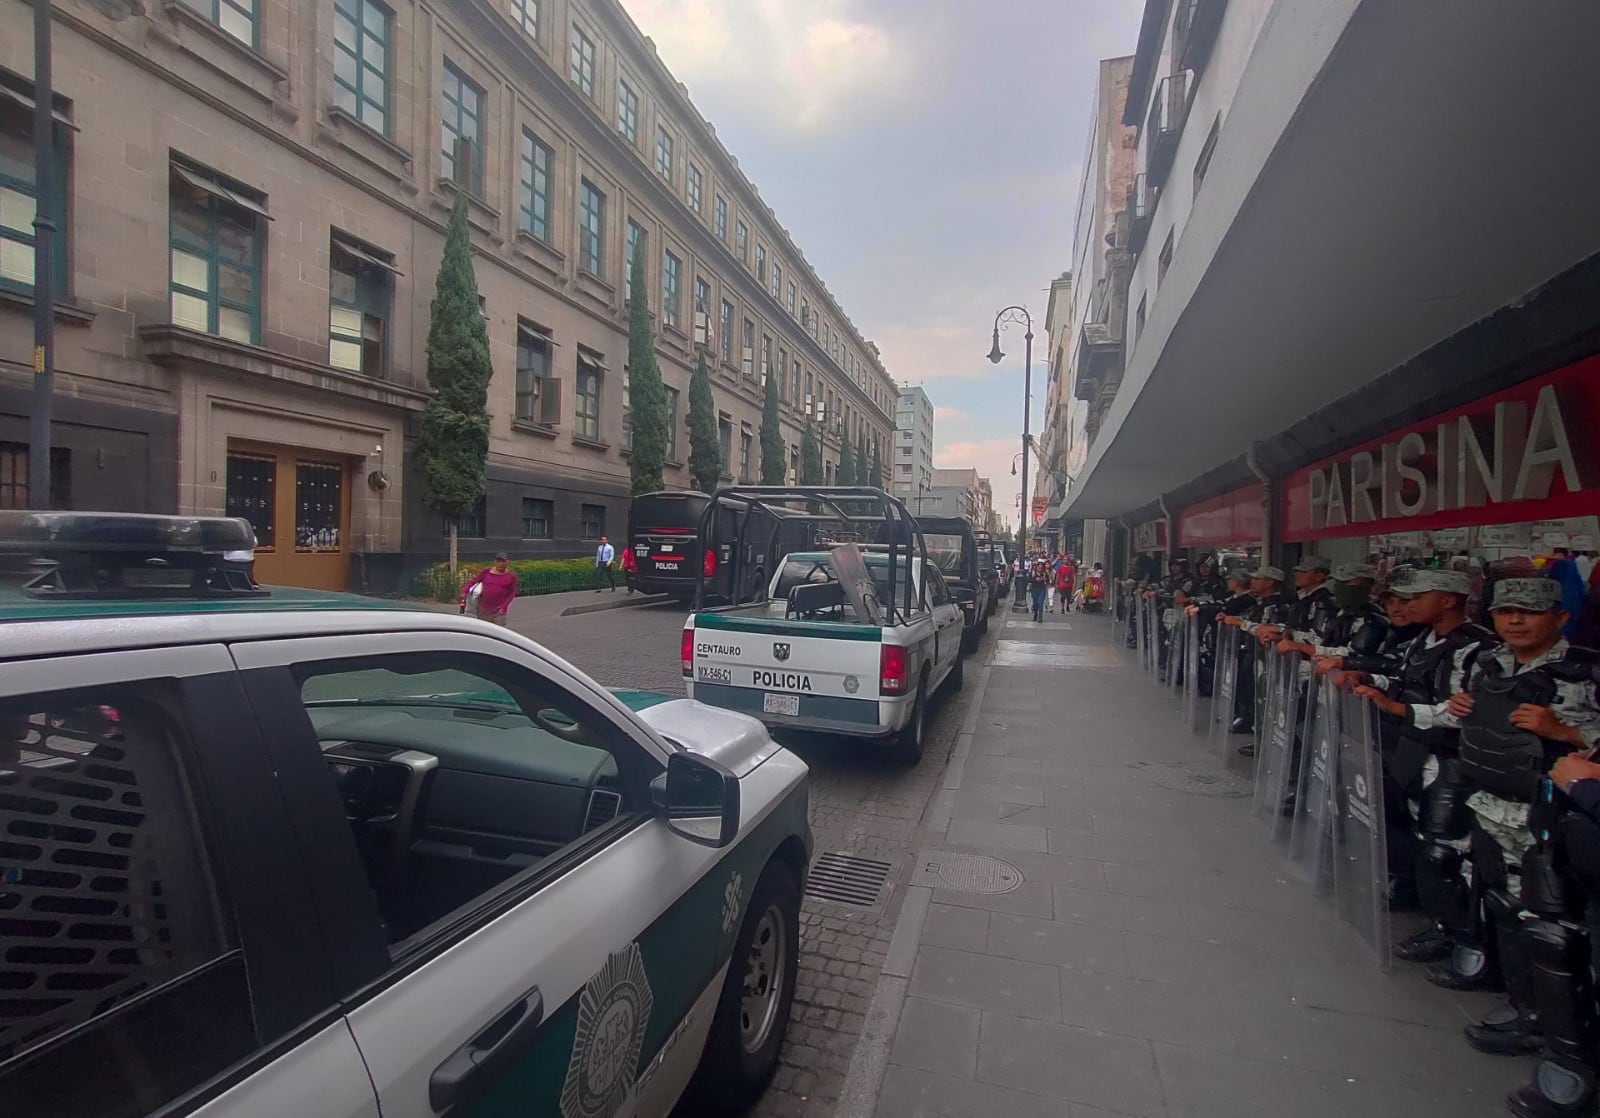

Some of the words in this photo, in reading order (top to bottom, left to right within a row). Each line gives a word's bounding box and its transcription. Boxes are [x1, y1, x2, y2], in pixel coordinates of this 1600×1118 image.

[1309, 384, 1581, 529] PARISINA
[655, 562, 678, 570] POLICIA
[697, 643, 741, 656] CENTAURO
[698, 666, 731, 681] MX-546-C1
[752, 670, 812, 691] POLICIA
